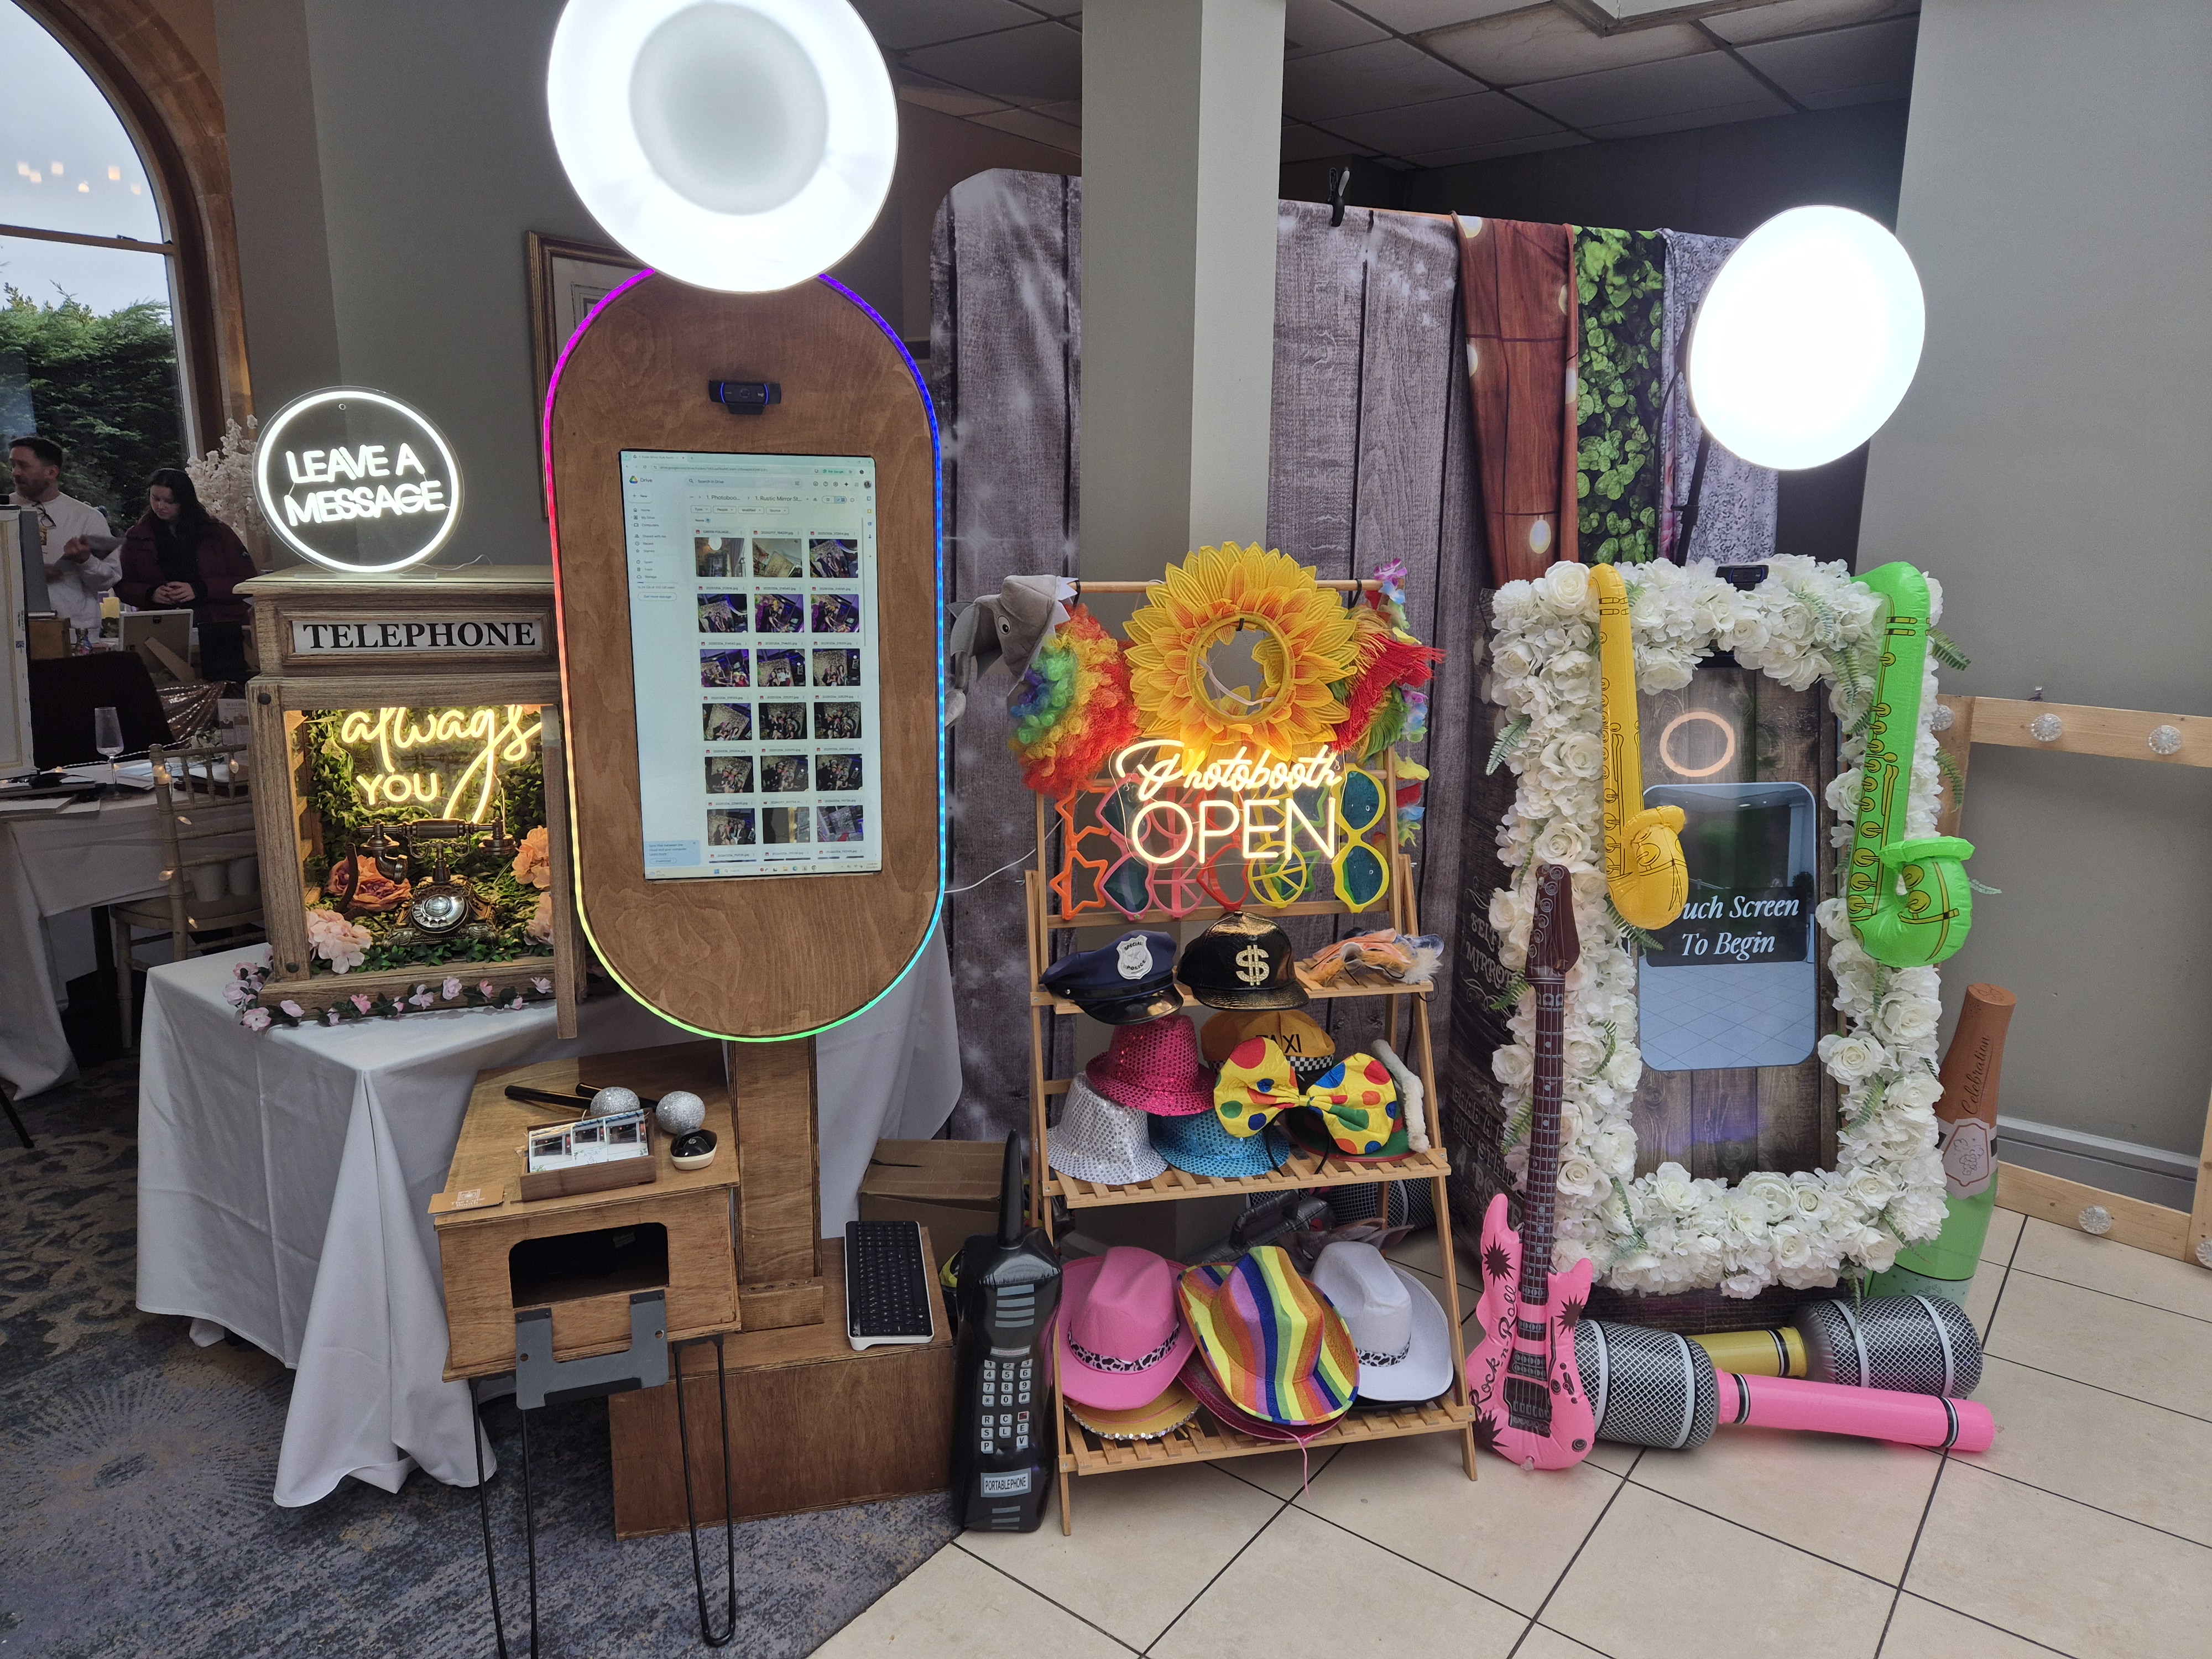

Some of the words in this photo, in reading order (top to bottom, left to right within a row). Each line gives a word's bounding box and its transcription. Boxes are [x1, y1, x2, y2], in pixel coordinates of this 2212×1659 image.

[285, 444, 389, 483] LEAVE
[395, 443, 425, 476] A
[284, 480, 446, 526] MESSAGE
[303, 622, 536, 649] TELEPHONE
[341, 705, 542, 823] always
[356, 773, 437, 806] YOU
[1131, 797, 1336, 864] OPEN
[1679, 895, 1724, 920] uch
[1729, 895, 1799, 919] Screen
[1124, 941, 1142, 951] SPECIAL
[1682, 933, 1709, 956] To
[1713, 931, 1776, 961] Begin
[1126, 959, 1146, 970] POLICE
[1256, 1034, 1302, 1053] XI
[1960, 1035, 1990, 1115] Celebration
[1453, 1082, 1481, 1125] GRAB
[1453, 1111, 1474, 1148] AND
